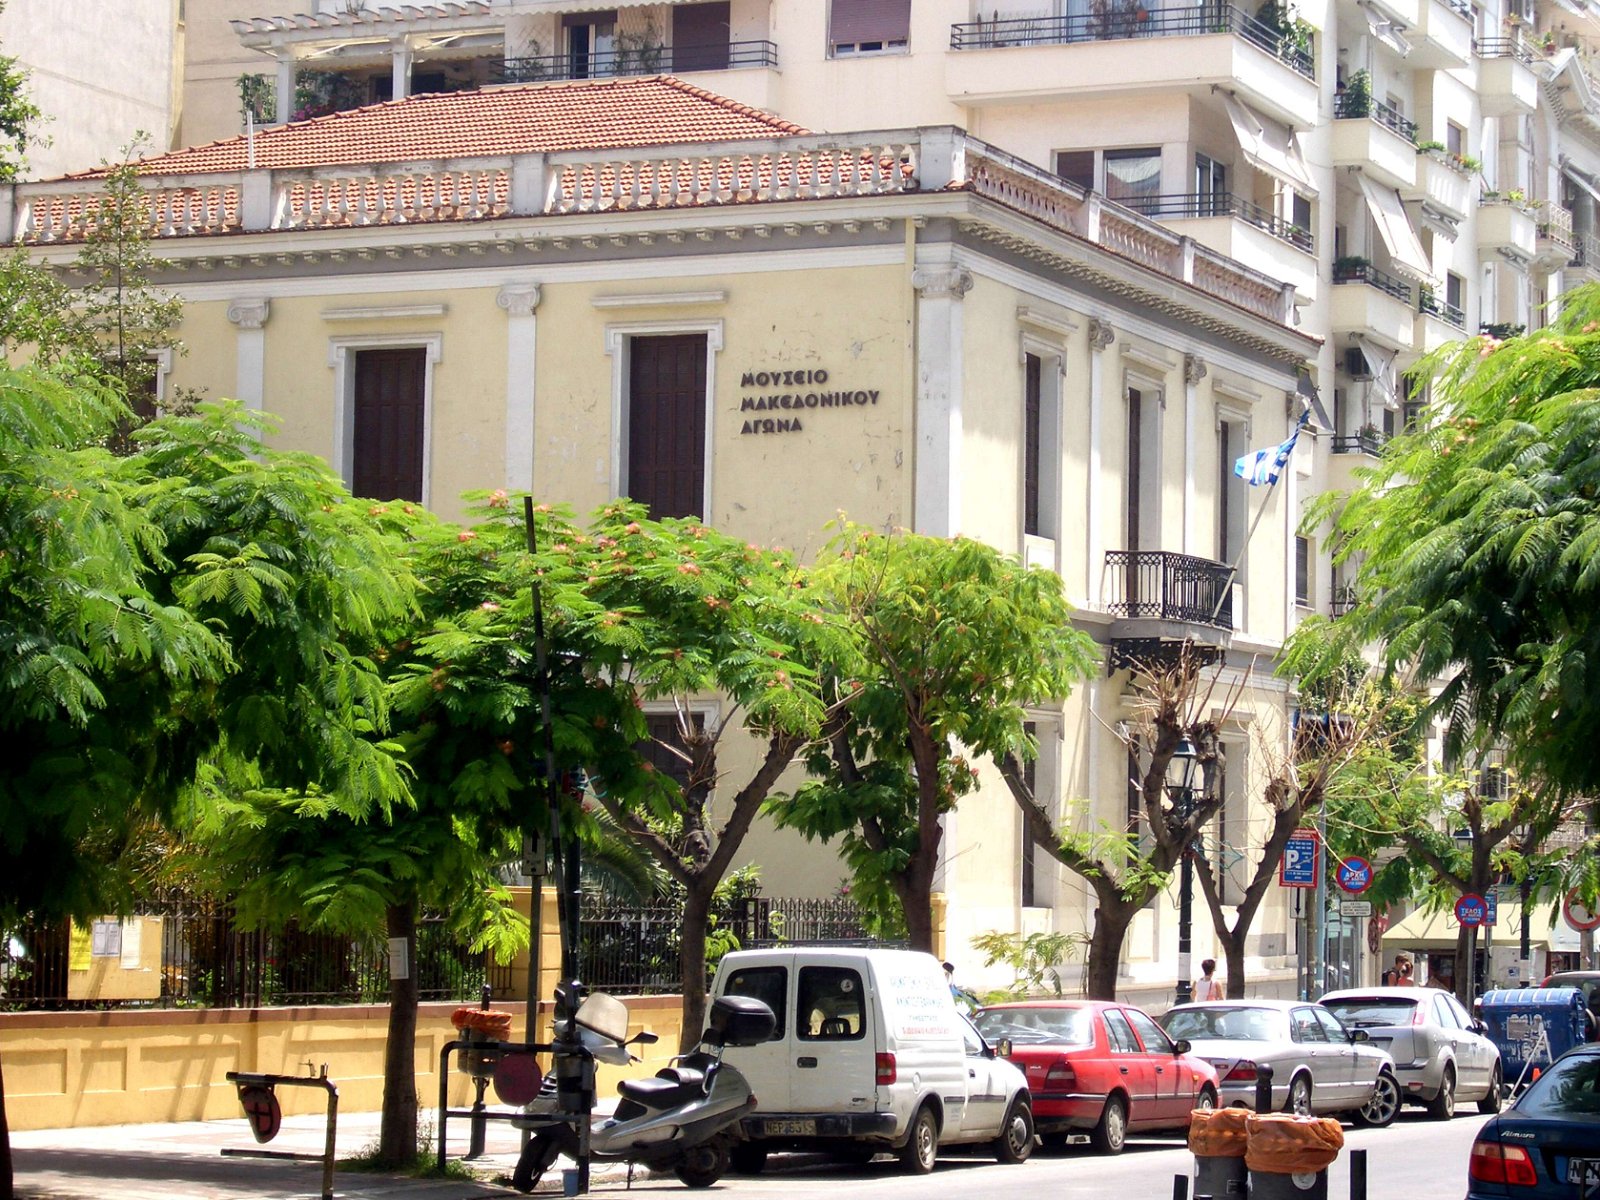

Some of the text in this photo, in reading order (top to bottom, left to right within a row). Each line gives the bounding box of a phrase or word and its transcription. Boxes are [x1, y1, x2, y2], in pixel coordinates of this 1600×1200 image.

[741, 369, 828, 387] ΜΟΥΣΕΙΟ
[741, 390, 880, 411] ΜΑΚΕΔΟΝΙΚΟΥ
[741, 417, 802, 434] ΑΓΩΝΑ
[1286, 850, 1300, 869] P
